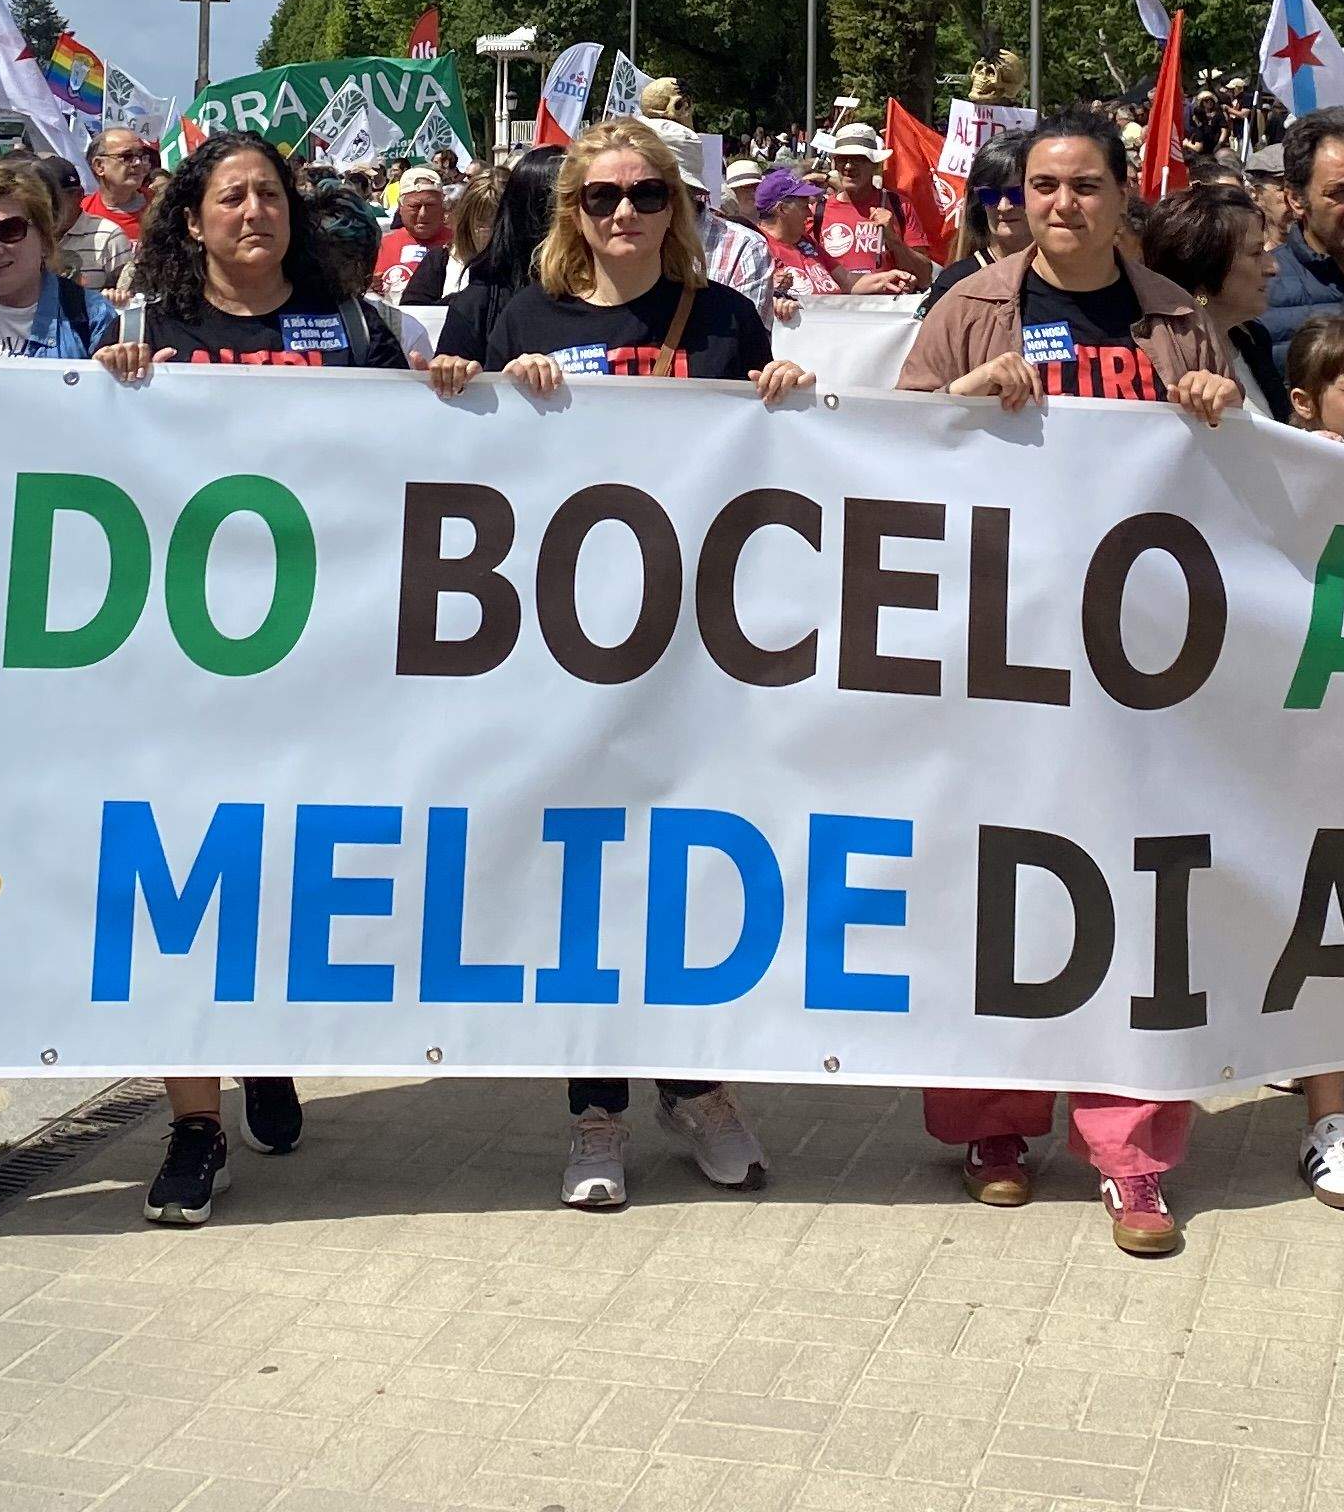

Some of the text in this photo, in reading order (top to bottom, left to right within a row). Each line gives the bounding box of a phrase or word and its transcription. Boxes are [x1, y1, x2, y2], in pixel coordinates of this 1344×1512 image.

[554, 76, 588, 102] bng
[1024, 349, 1072, 363] ELULOSA
[3, 471, 317, 677] DO
[396, 481, 1228, 711] BOCELO
[91, 800, 915, 1013] MELIDE
[974, 823, 1212, 1031] DI
